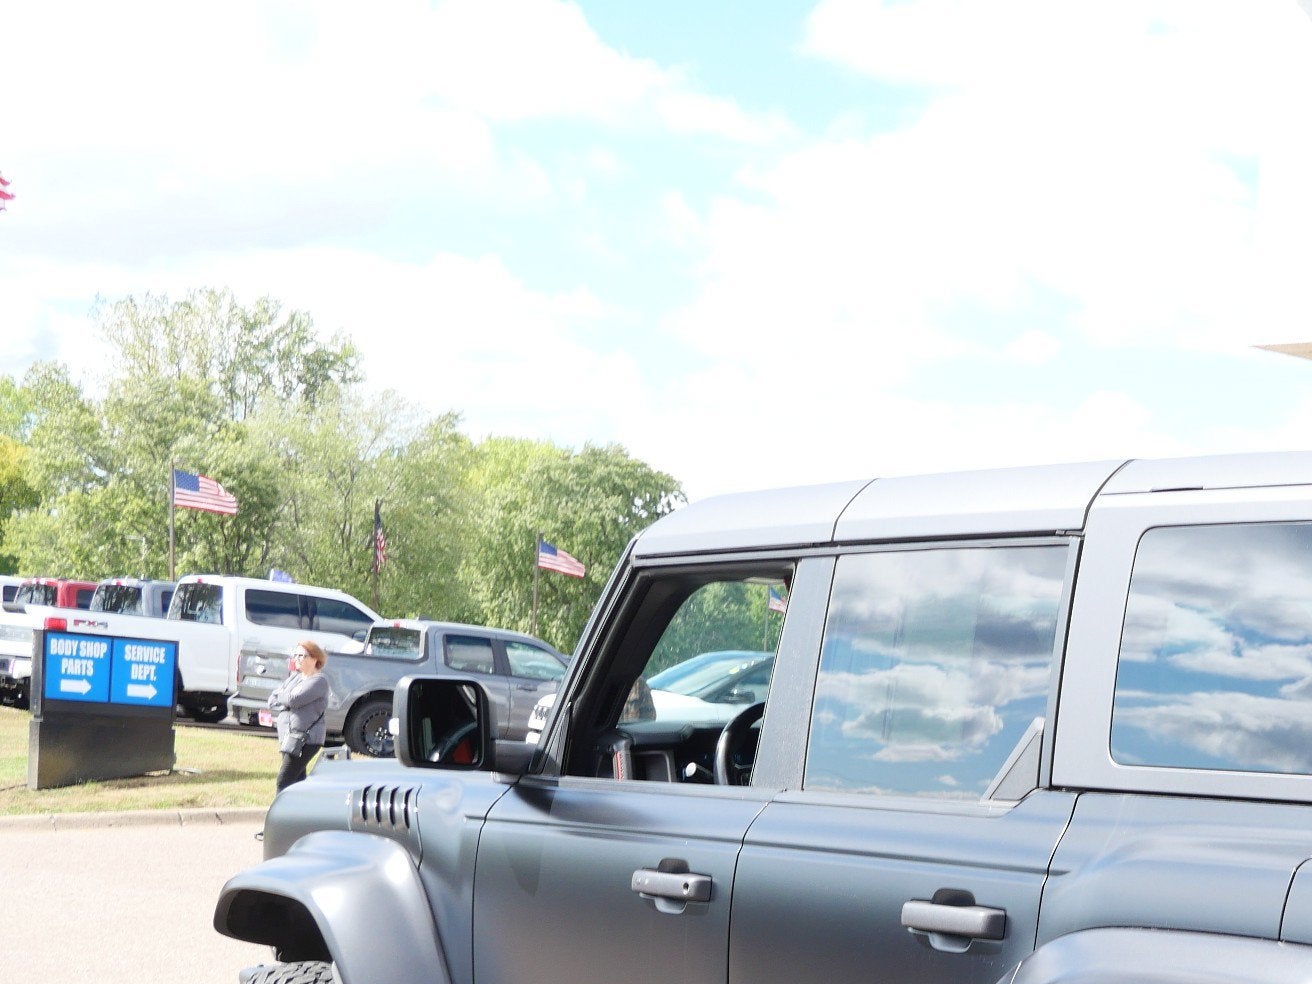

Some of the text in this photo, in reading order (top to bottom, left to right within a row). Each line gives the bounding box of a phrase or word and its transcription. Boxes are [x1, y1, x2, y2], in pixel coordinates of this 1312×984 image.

[50, 638, 107, 658] BODY SHOP
[124, 644, 166, 664] SERVICE
[61, 658, 94, 676] PARTS
[131, 663, 157, 681] DEPT.
